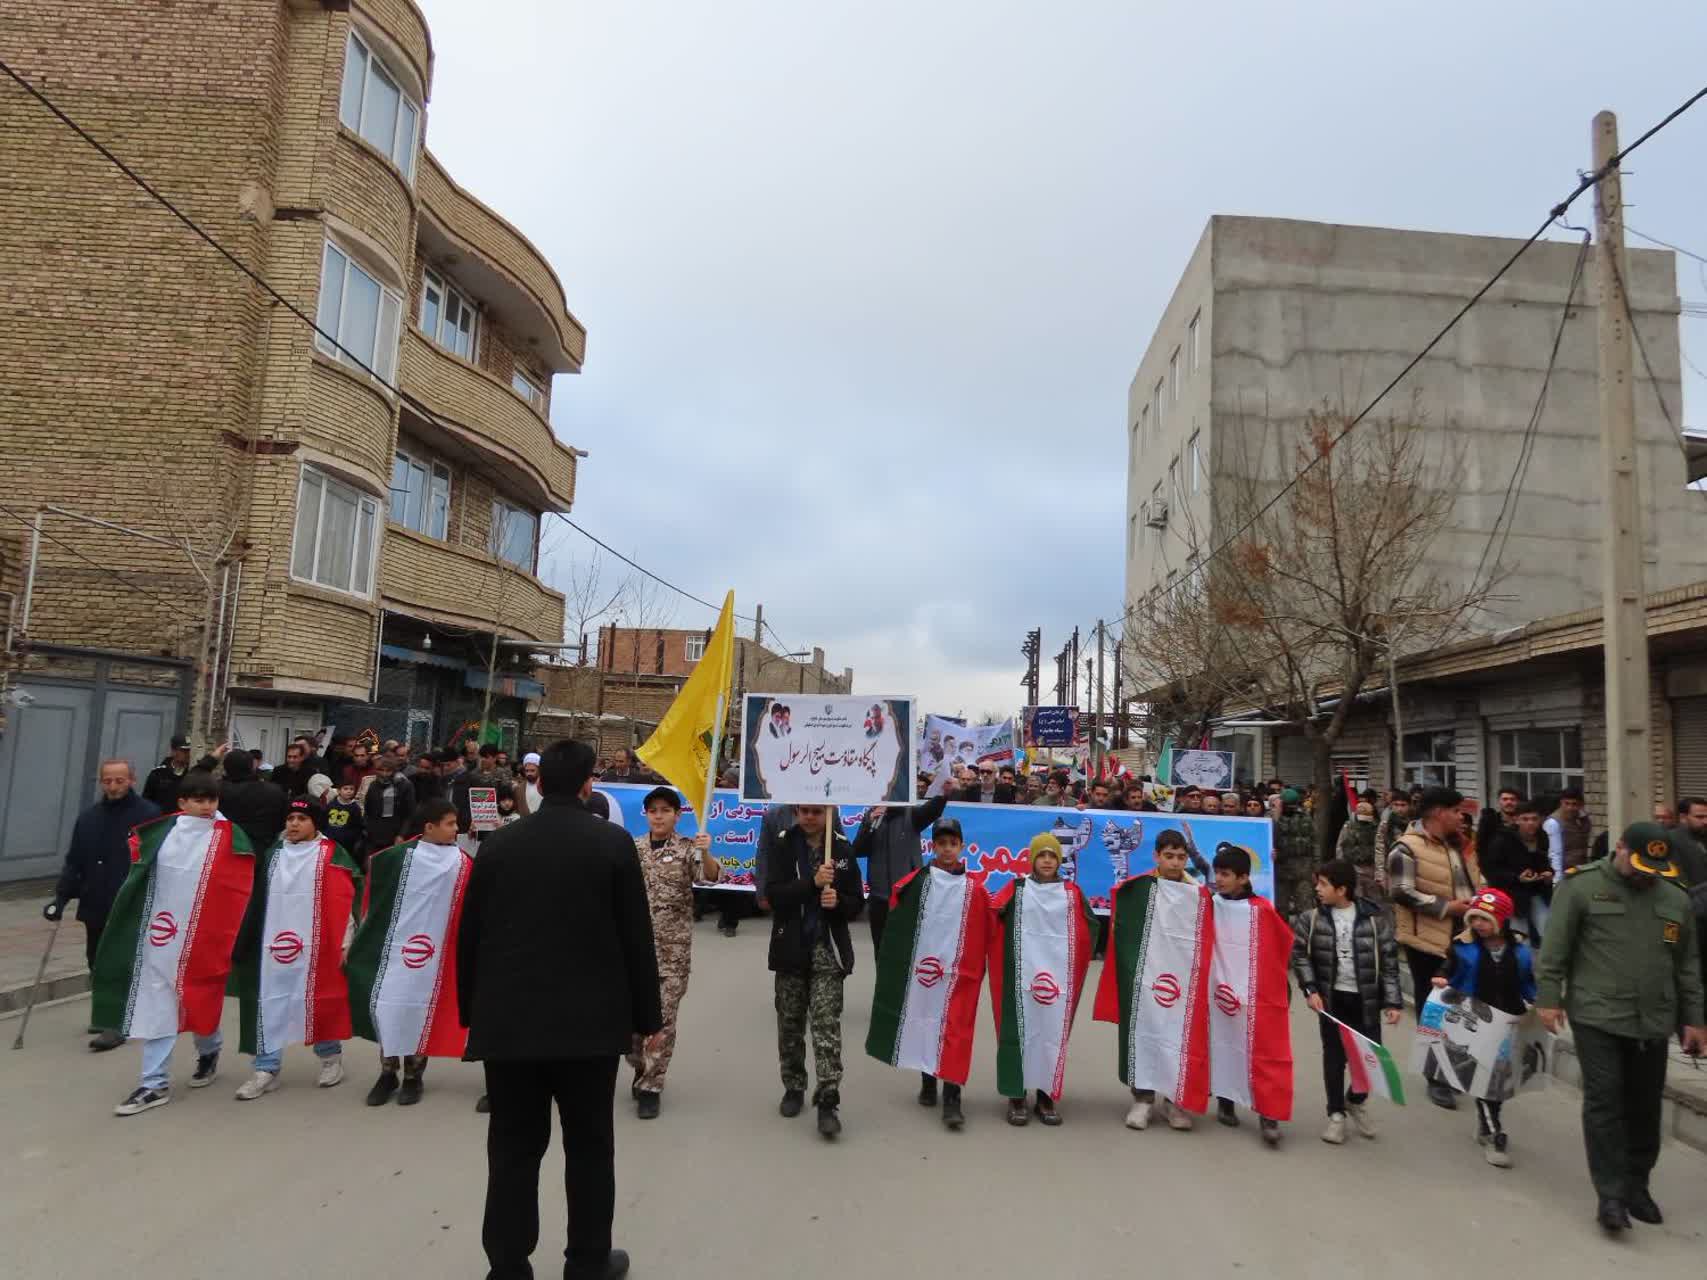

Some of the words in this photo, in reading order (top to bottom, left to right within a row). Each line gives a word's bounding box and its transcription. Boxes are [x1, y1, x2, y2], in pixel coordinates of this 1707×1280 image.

[810, 738, 827, 775] بسیج
[823, 748, 859, 767] مقاومت
[857, 739, 878, 778] پایگاه
[725, 829, 754, 844] است
